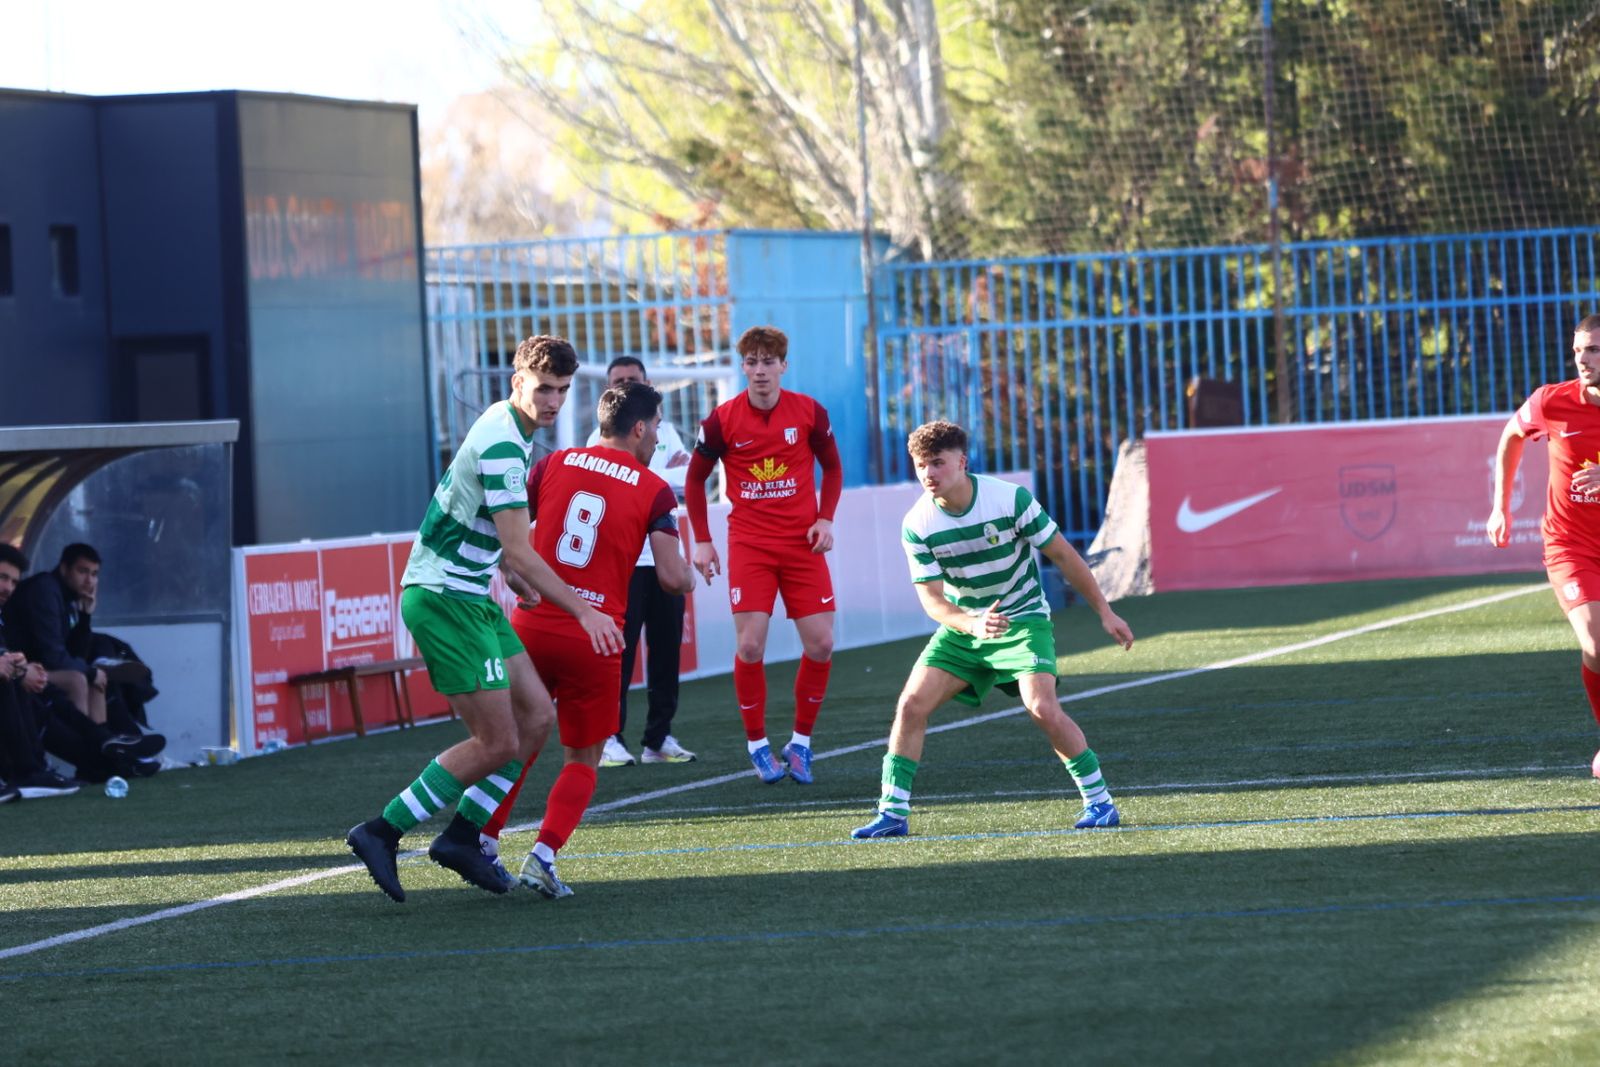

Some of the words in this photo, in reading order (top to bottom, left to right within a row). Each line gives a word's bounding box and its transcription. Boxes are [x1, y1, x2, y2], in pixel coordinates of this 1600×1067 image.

[563, 452, 640, 487] GÁNDARA
[740, 481, 763, 492] CAJA
[765, 478, 798, 490] RURAL
[556, 490, 606, 569] 8
[484, 657, 504, 682] 16
